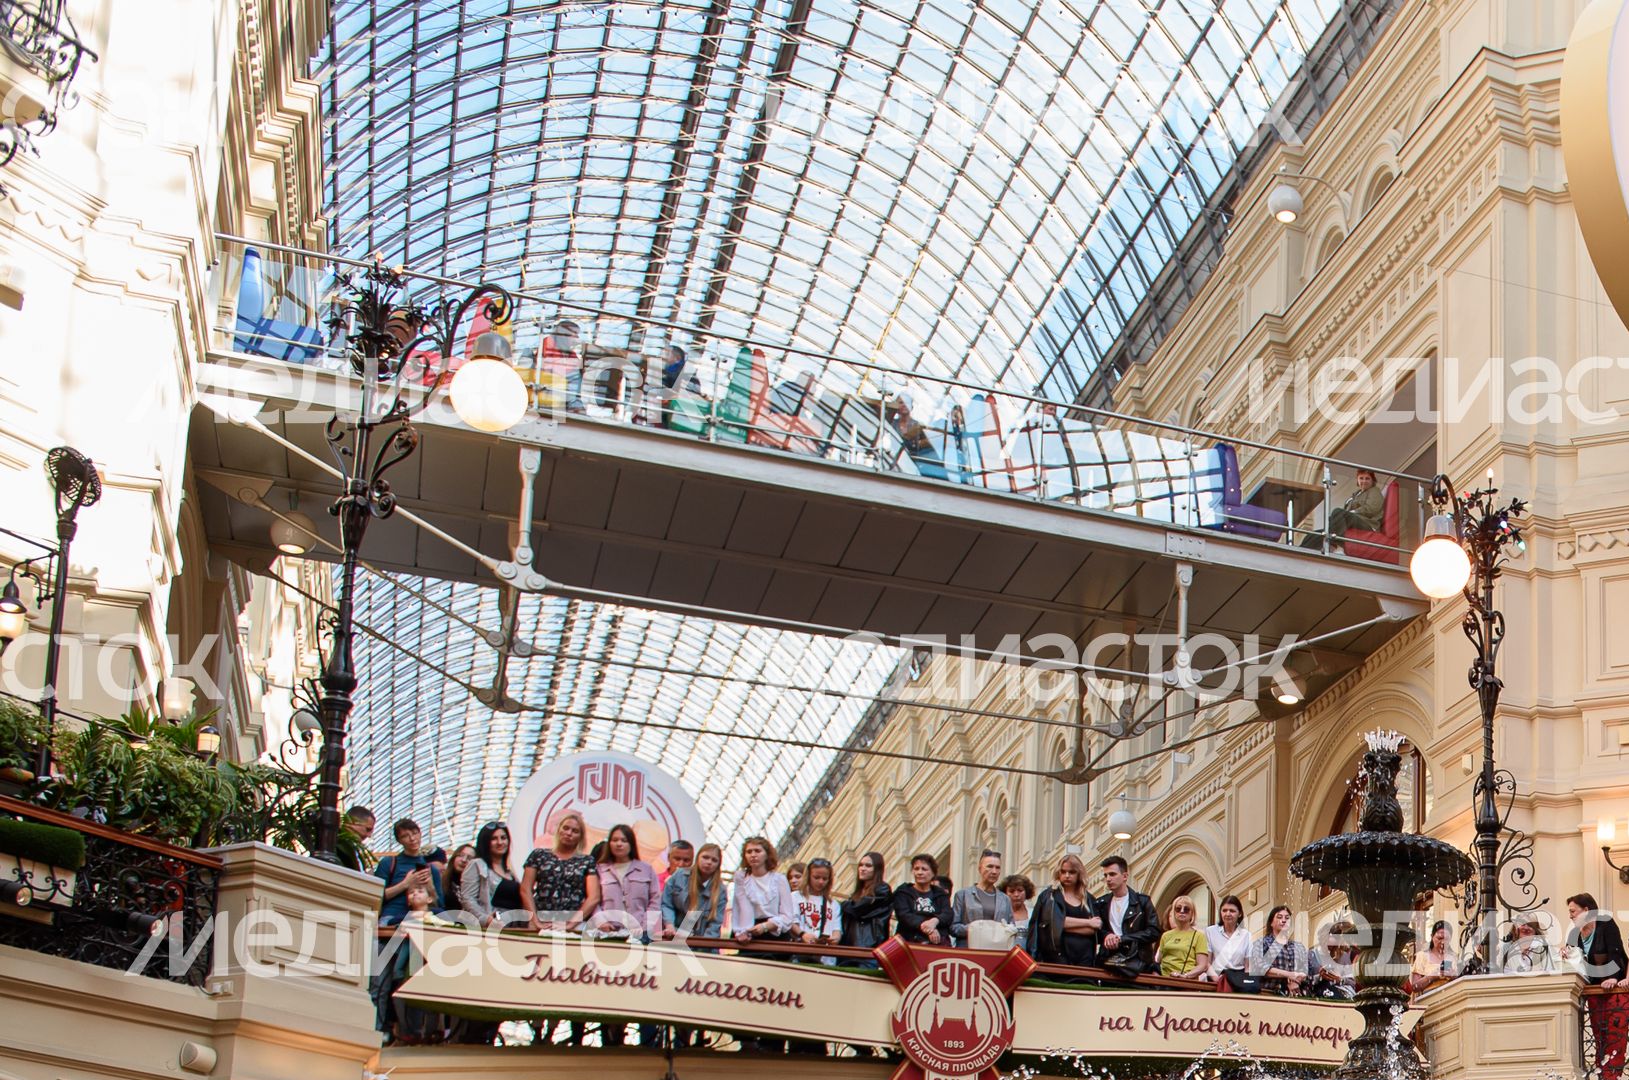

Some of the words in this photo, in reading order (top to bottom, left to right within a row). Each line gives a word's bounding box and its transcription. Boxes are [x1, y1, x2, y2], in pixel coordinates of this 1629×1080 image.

[577, 762, 646, 810] ГУМ
[799, 902, 833, 921] BULS
[520, 953, 659, 990] Главный
[674, 975, 805, 1010] магазин
[932, 962, 981, 1000] ГУМ
[943, 1039, 965, 1049] 1893
[1098, 1014, 1134, 1032] на
[1143, 1005, 1252, 1040] Красной
[1258, 1019, 1353, 1048] площади
[906, 1037, 950, 1072] КРАСНАЯ
[952, 1043, 1001, 1072] ПЛОЩАДЬ
